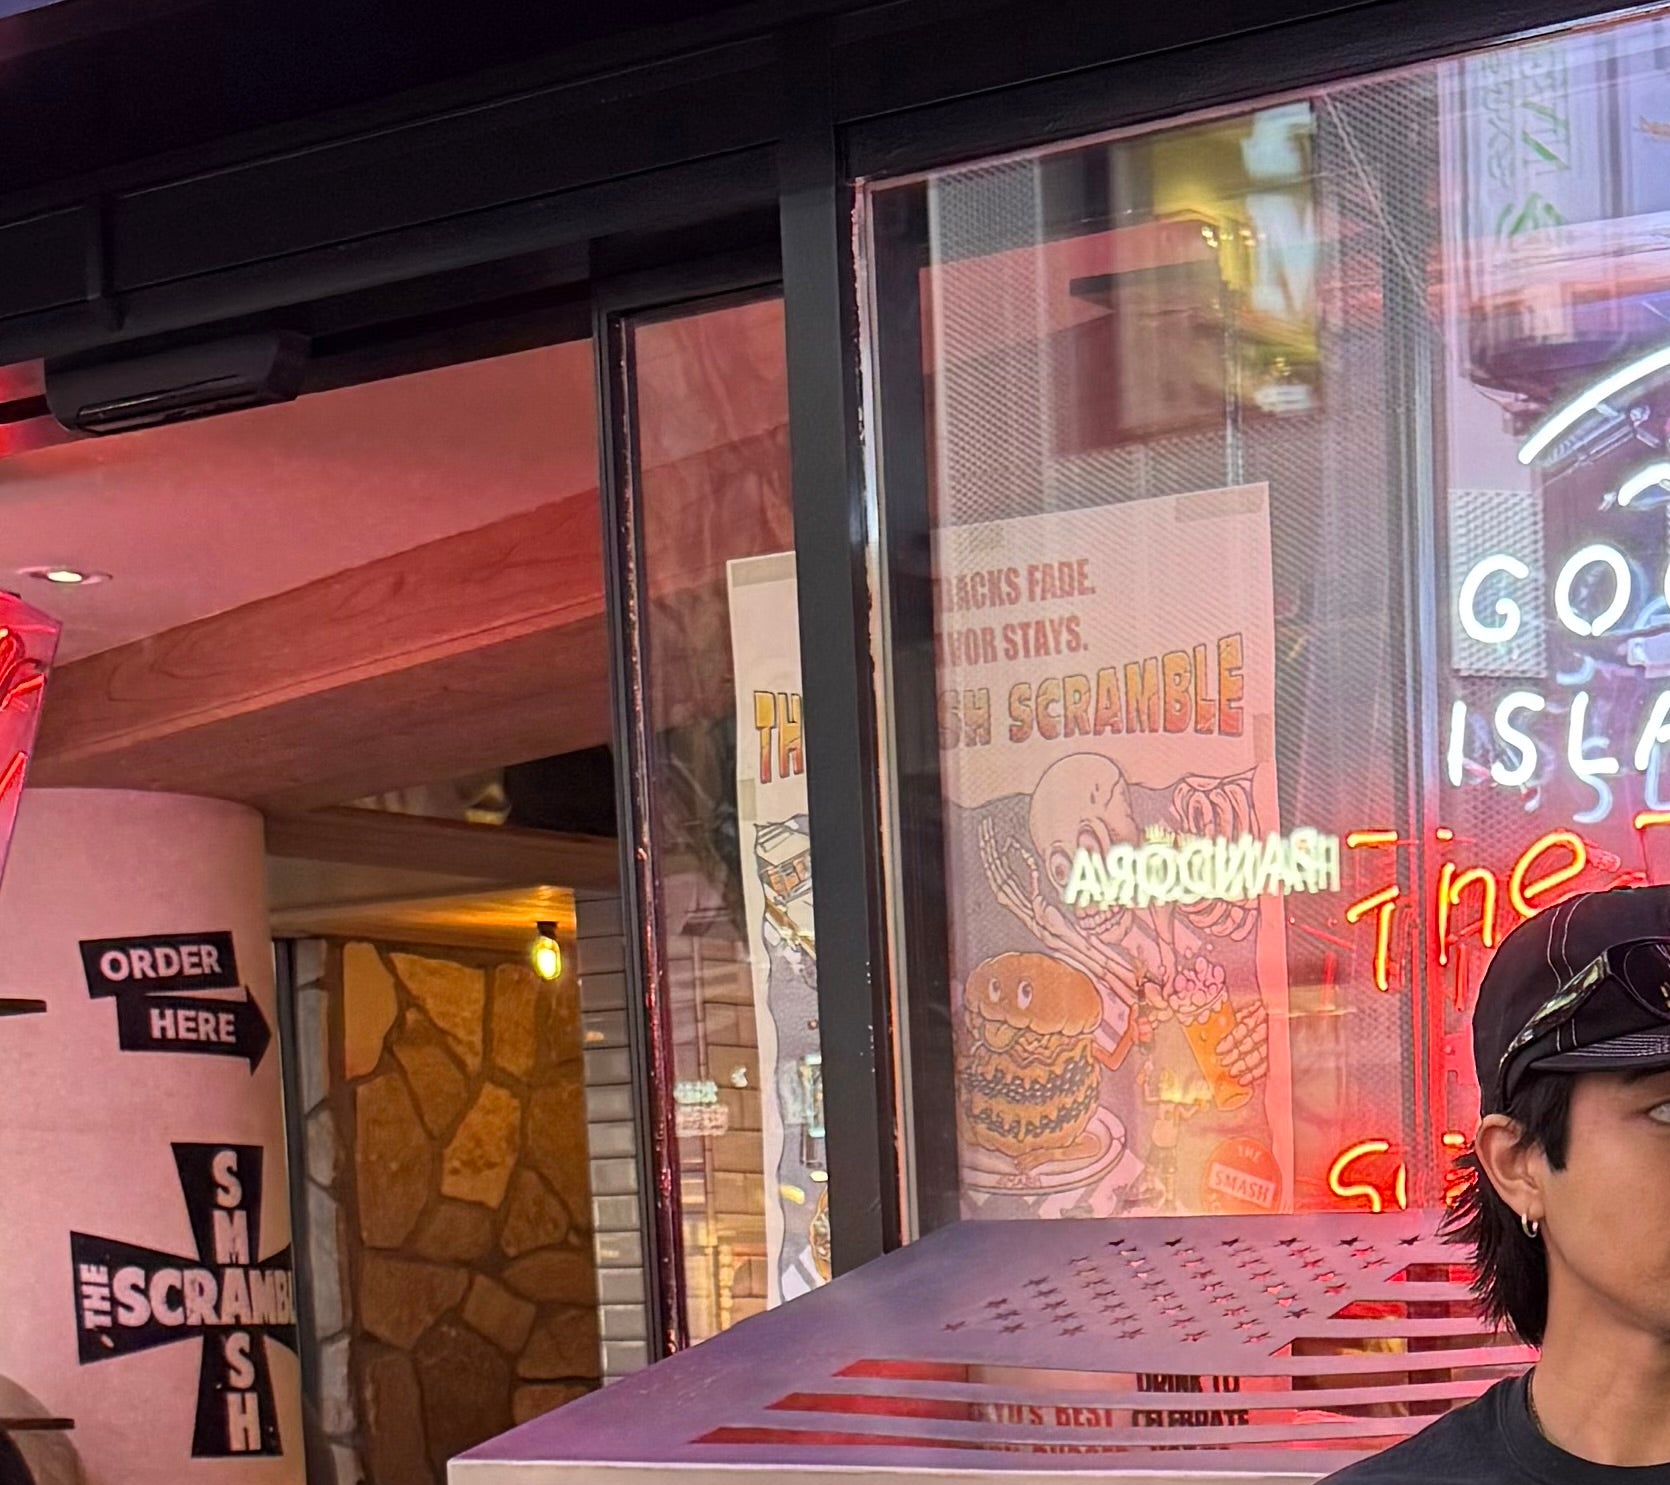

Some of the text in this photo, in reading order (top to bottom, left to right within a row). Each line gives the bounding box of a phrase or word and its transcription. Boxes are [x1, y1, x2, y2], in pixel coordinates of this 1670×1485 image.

[1027, 558, 1096, 602] FADE.
[1003, 615, 1089, 661] STAYS.
[1009, 632, 1245, 744] SCRAMBLE
[753, 690, 804, 784] TH
[100, 945, 222, 981] ORDER
[150, 1008, 236, 1043] HERE
[79, 1264, 112, 1329] THE
